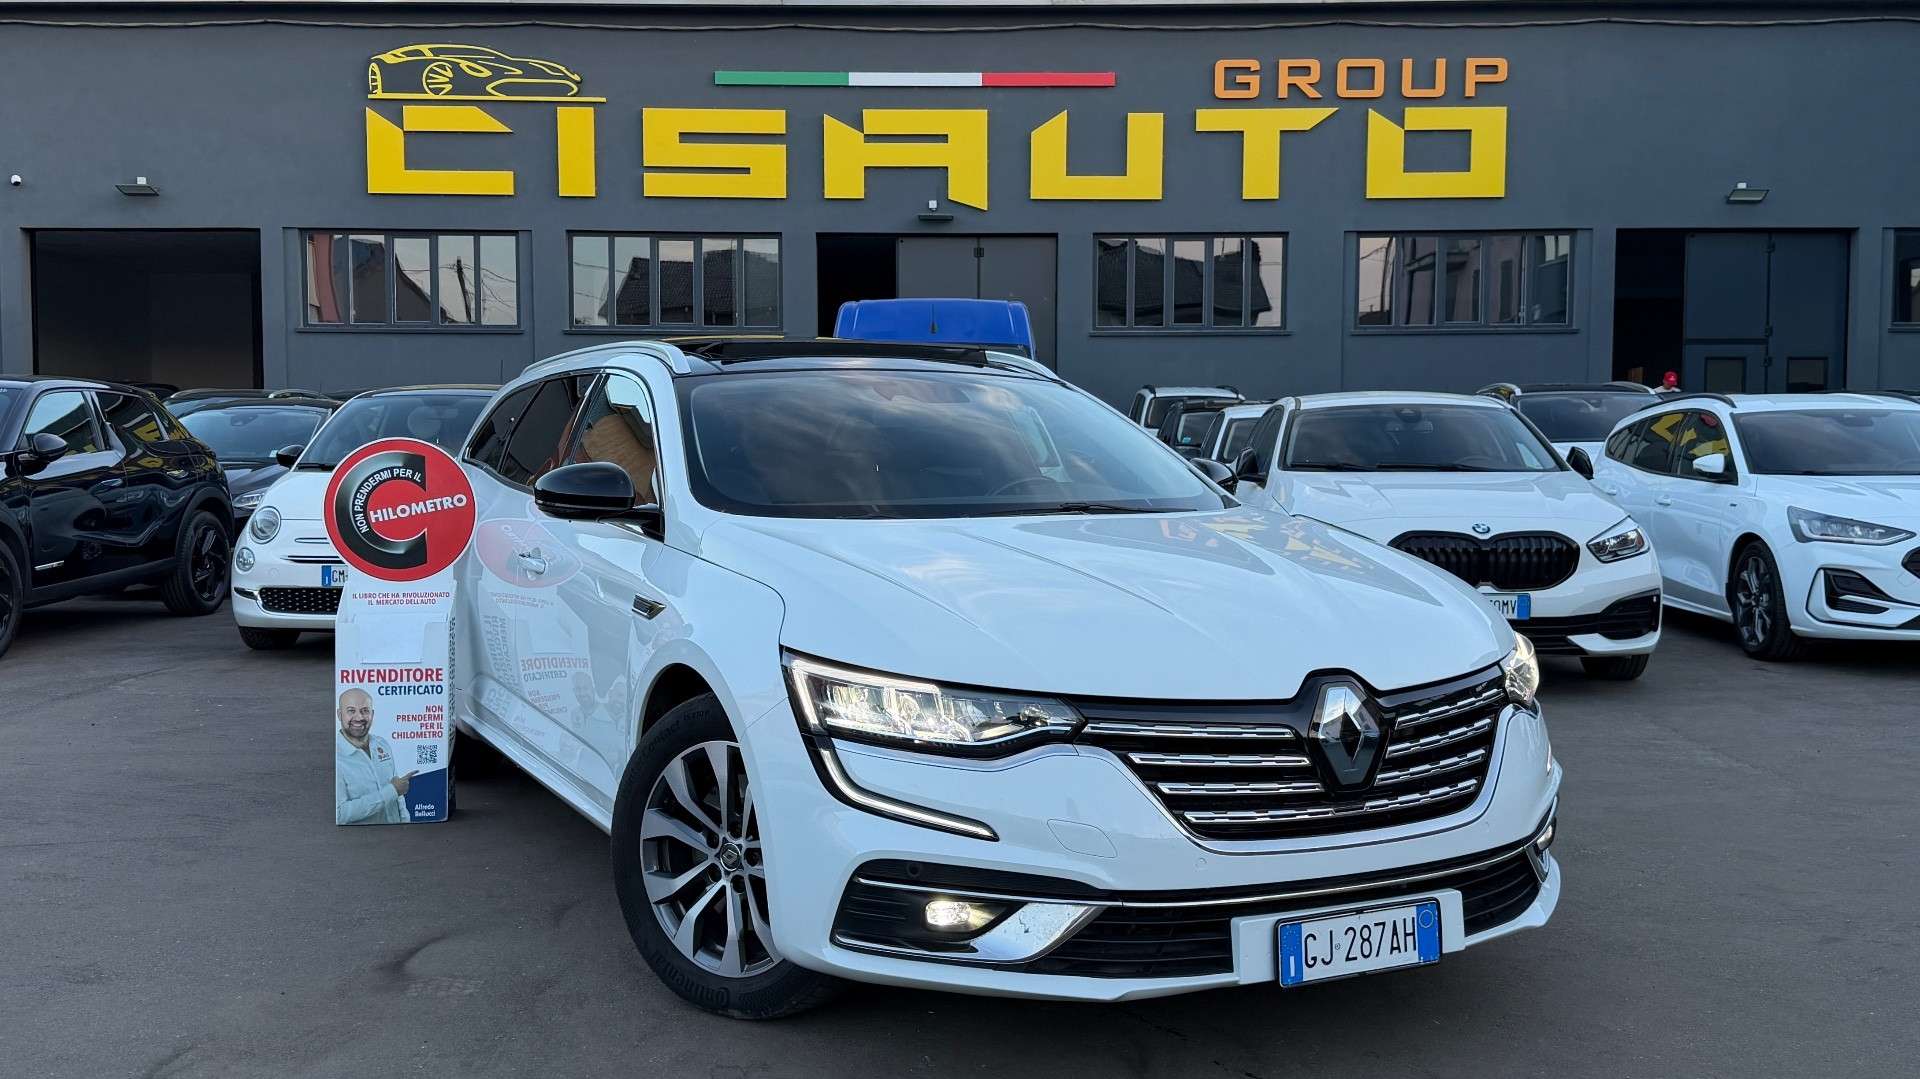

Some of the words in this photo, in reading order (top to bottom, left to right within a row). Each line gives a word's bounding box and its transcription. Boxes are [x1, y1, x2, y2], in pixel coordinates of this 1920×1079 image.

[1214, 58, 1508, 98] GROUP
[366, 106, 1507, 210] CISAUTO
[393, 468, 413, 479] PER
[413, 471, 422, 483] IL
[354, 469, 392, 511] PRENDERMI
[354, 513, 369, 534] NON
[340, 668, 443, 684] RIVENDITORE
[378, 684, 443, 696] CERTIFICATO
[425, 705, 443, 713] NON
[396, 713, 443, 722] PRENDERMI
[420, 722, 435, 730] PER
[436, 722, 444, 730] IL
[391, 731, 443, 739] CHILOMETRO
